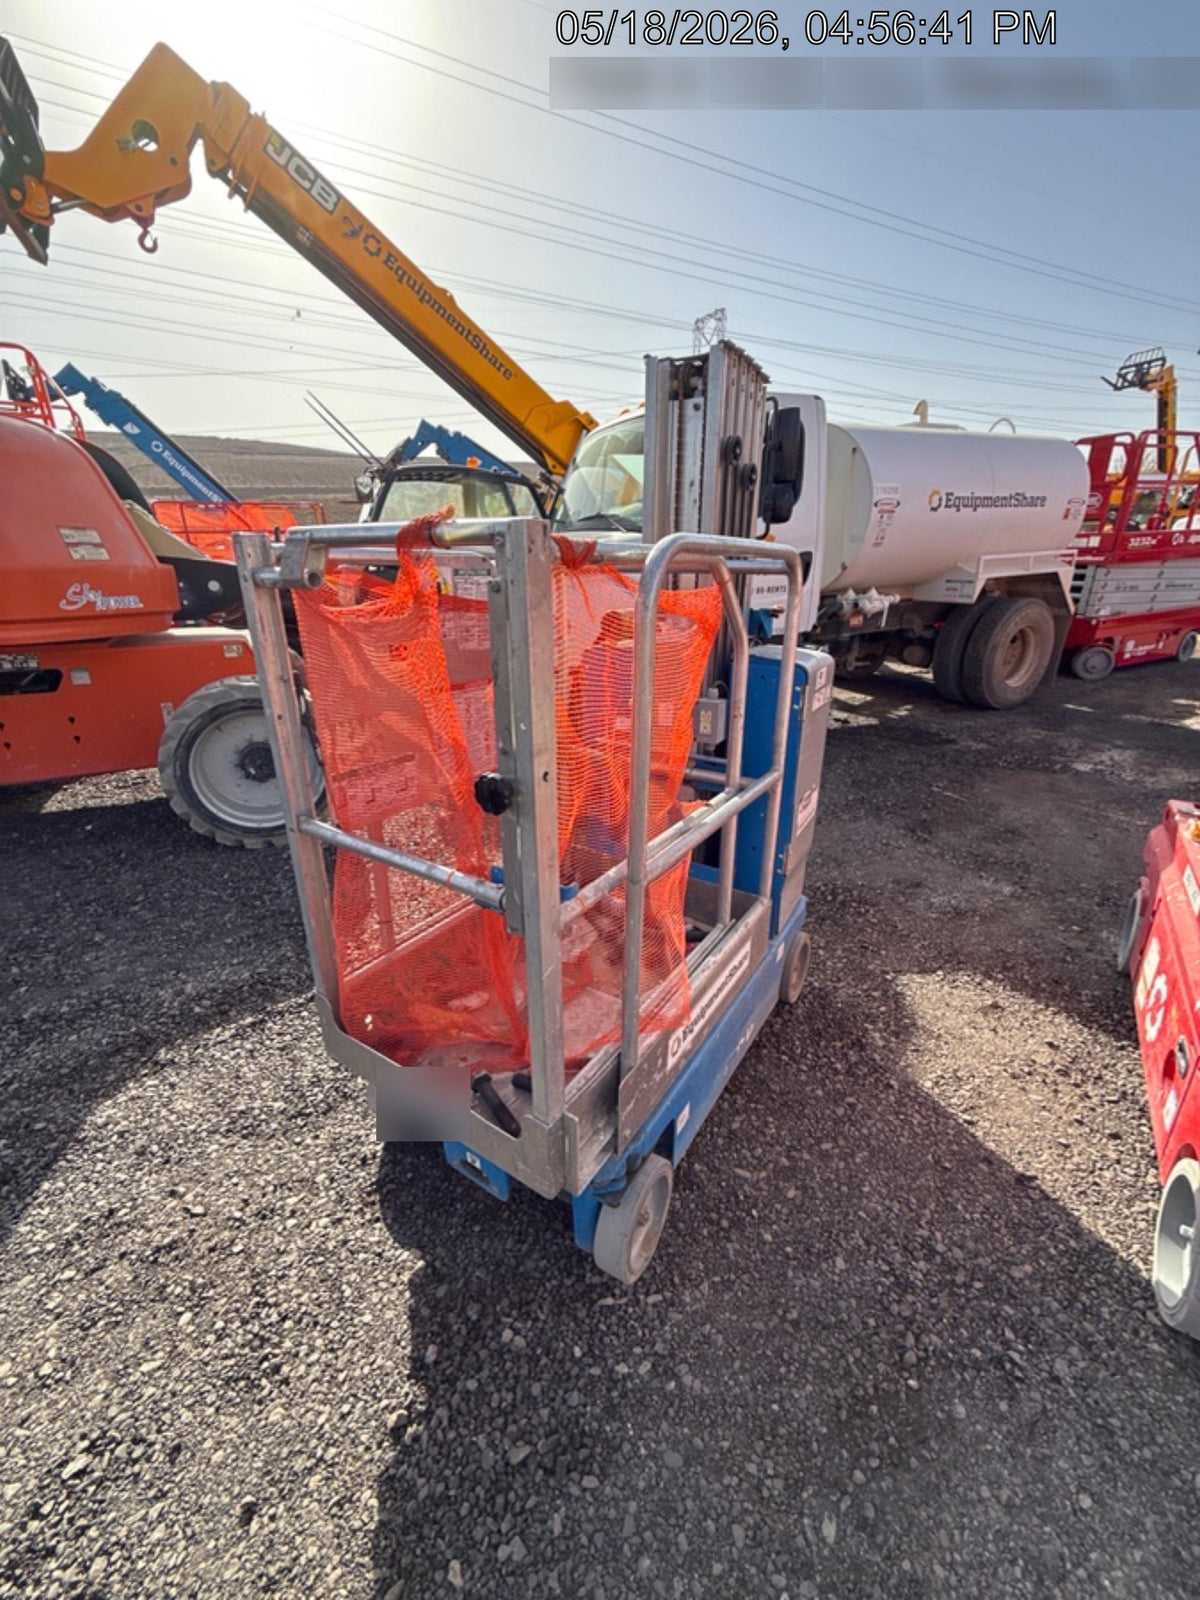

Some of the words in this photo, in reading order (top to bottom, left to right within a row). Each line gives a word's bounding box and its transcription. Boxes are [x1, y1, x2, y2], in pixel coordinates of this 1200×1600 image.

[265, 134, 340, 213] JCB
[383, 252, 512, 380] EquipmentShare
[944, 492, 1047, 512] EquipmentShare
